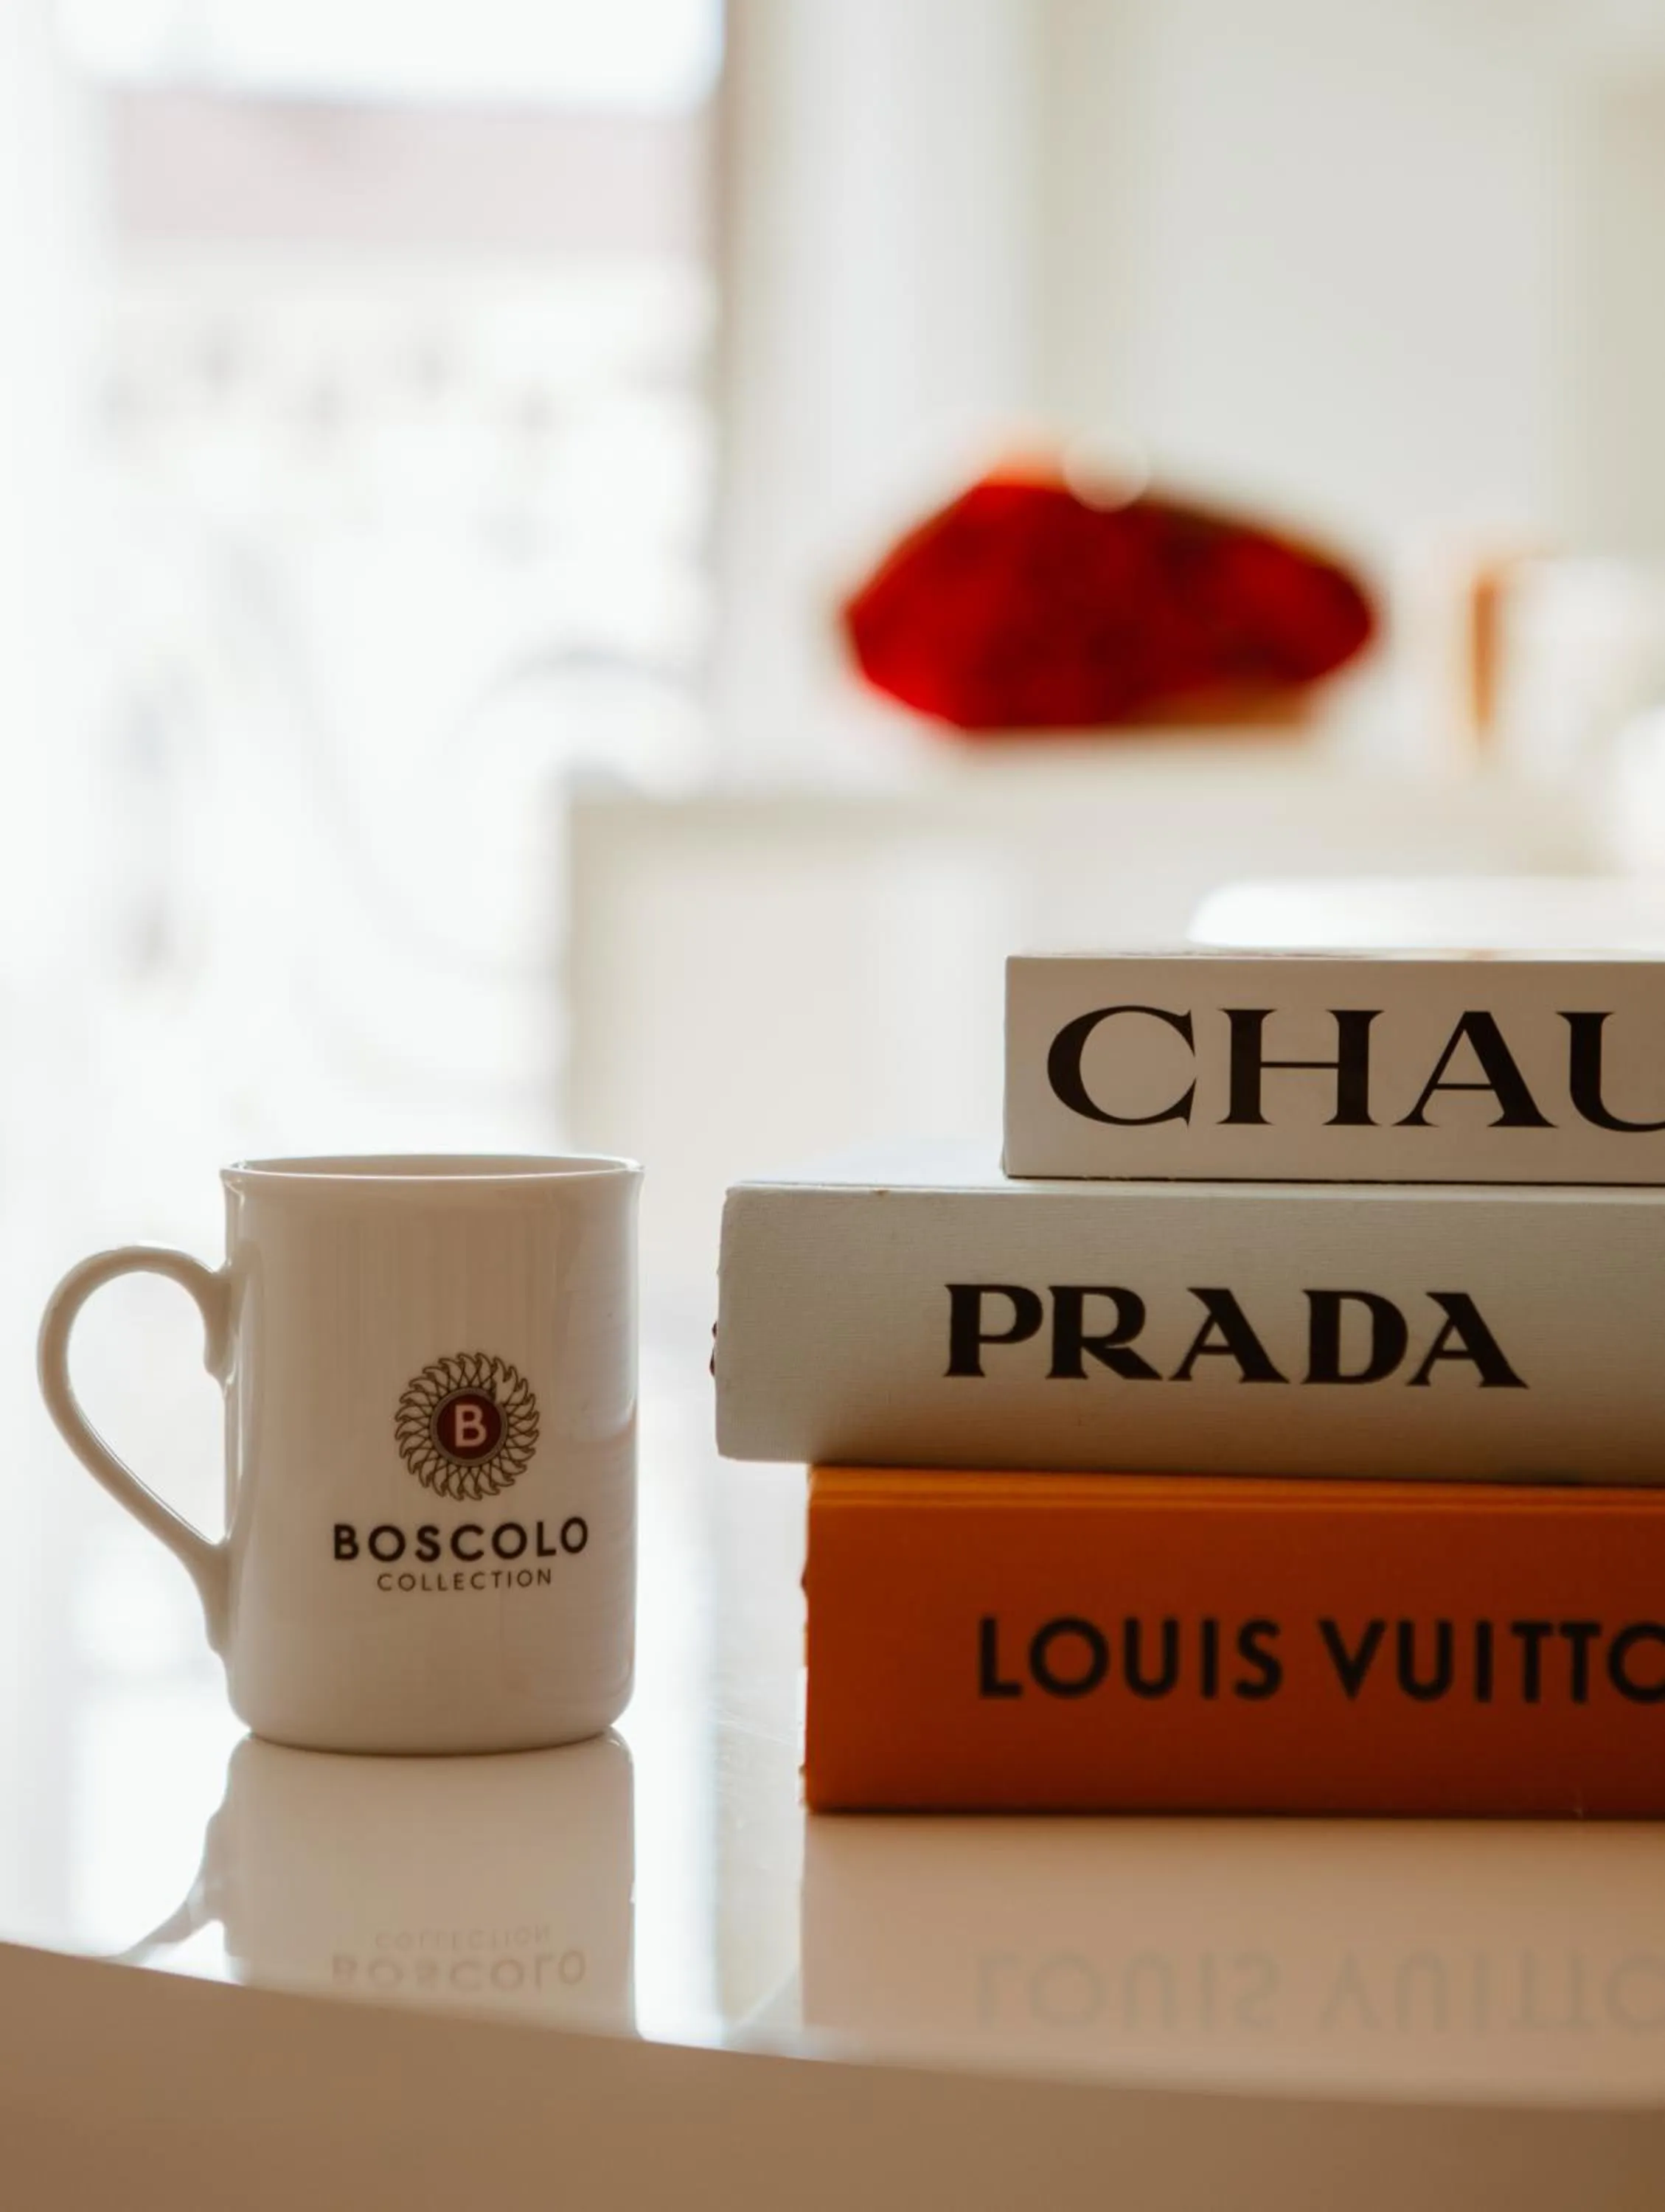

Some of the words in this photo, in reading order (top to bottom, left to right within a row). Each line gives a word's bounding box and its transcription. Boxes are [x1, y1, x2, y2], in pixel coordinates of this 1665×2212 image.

[943, 1284, 1529, 1388] PRADA
[453, 1403, 487, 1448] B
[333, 1516, 588, 1563] BOSCOLO
[377, 1568, 552, 1592] COLLECTION
[978, 1615, 1284, 1701] LOUIS
[1317, 1616, 1665, 1705] VUITTO
